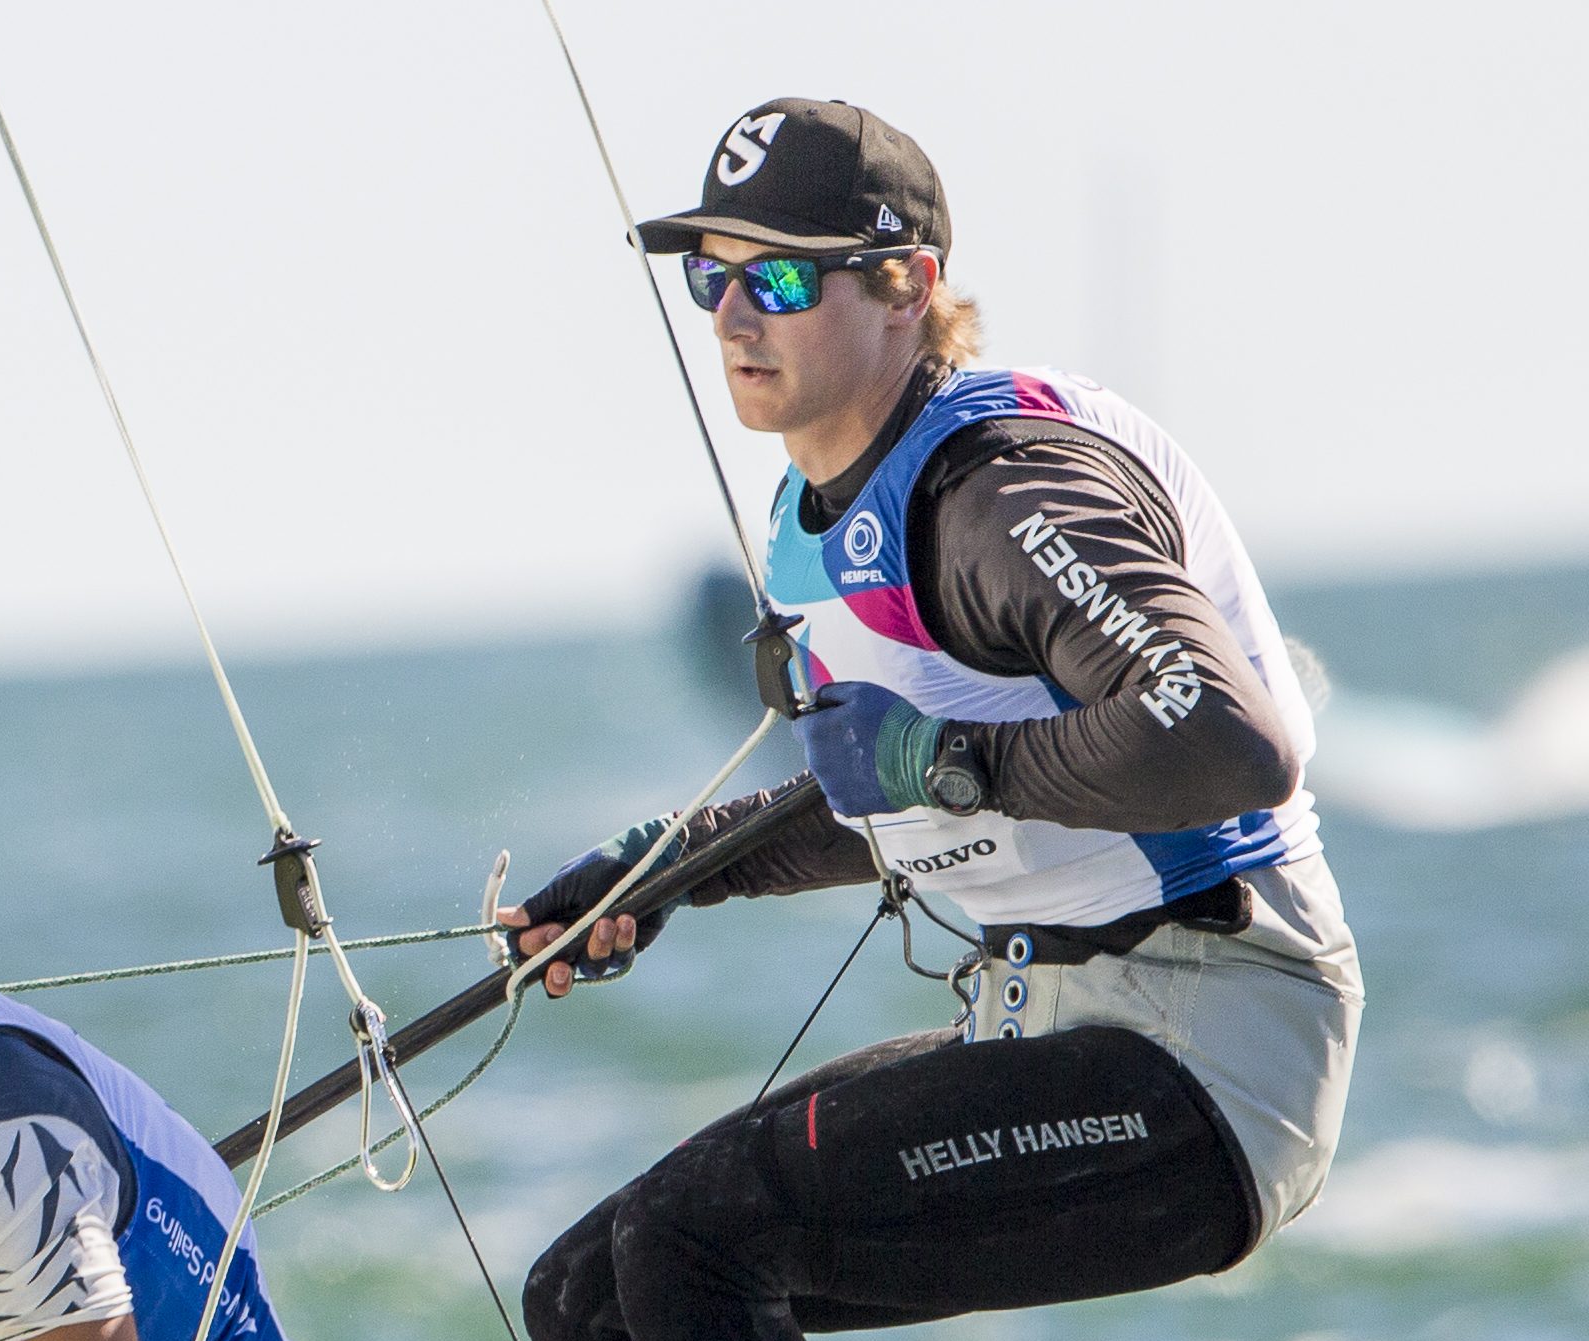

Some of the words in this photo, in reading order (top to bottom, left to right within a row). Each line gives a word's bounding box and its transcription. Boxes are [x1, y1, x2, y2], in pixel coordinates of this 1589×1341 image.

[840, 569, 887, 585] HEMPEL
[1009, 511, 1161, 654] HANSEN
[895, 838, 997, 874] VOLVO
[898, 1128, 1004, 1181] HELLY
[1011, 1111, 1149, 1155] HANSEN
[145, 1197, 205, 1277] Sailing
